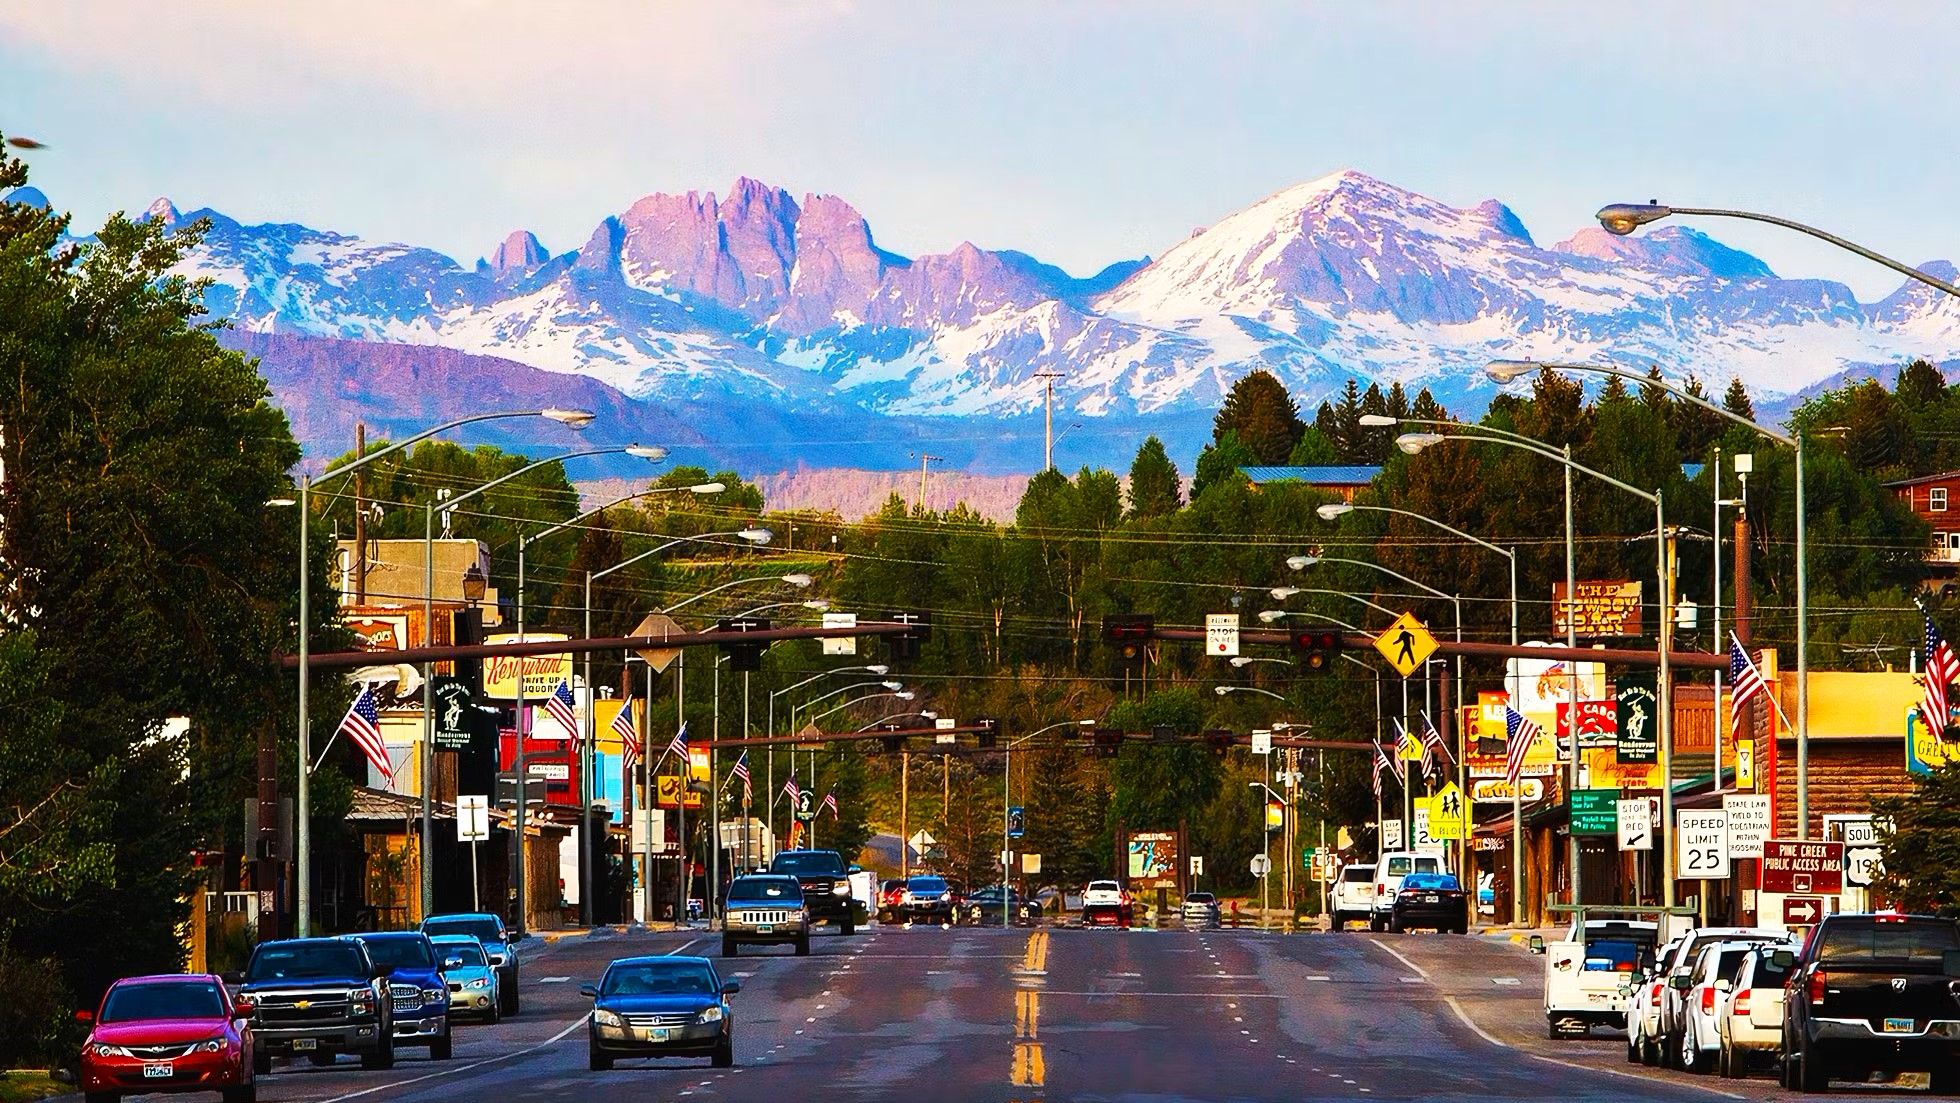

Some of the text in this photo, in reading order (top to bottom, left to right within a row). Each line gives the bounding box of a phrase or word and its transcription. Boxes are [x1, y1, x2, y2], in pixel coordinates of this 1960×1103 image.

[1578, 585, 1621, 597] THE
[1622, 804, 1645, 813] STOP
[1683, 819, 1724, 829] SPEED
[1687, 835, 1719, 844] LIMIT
[1779, 845, 1827, 858] PINE CREEK
[1688, 849, 1720, 870] 25
[1765, 858, 1842, 872] PUBLIC ACCESS AREA
